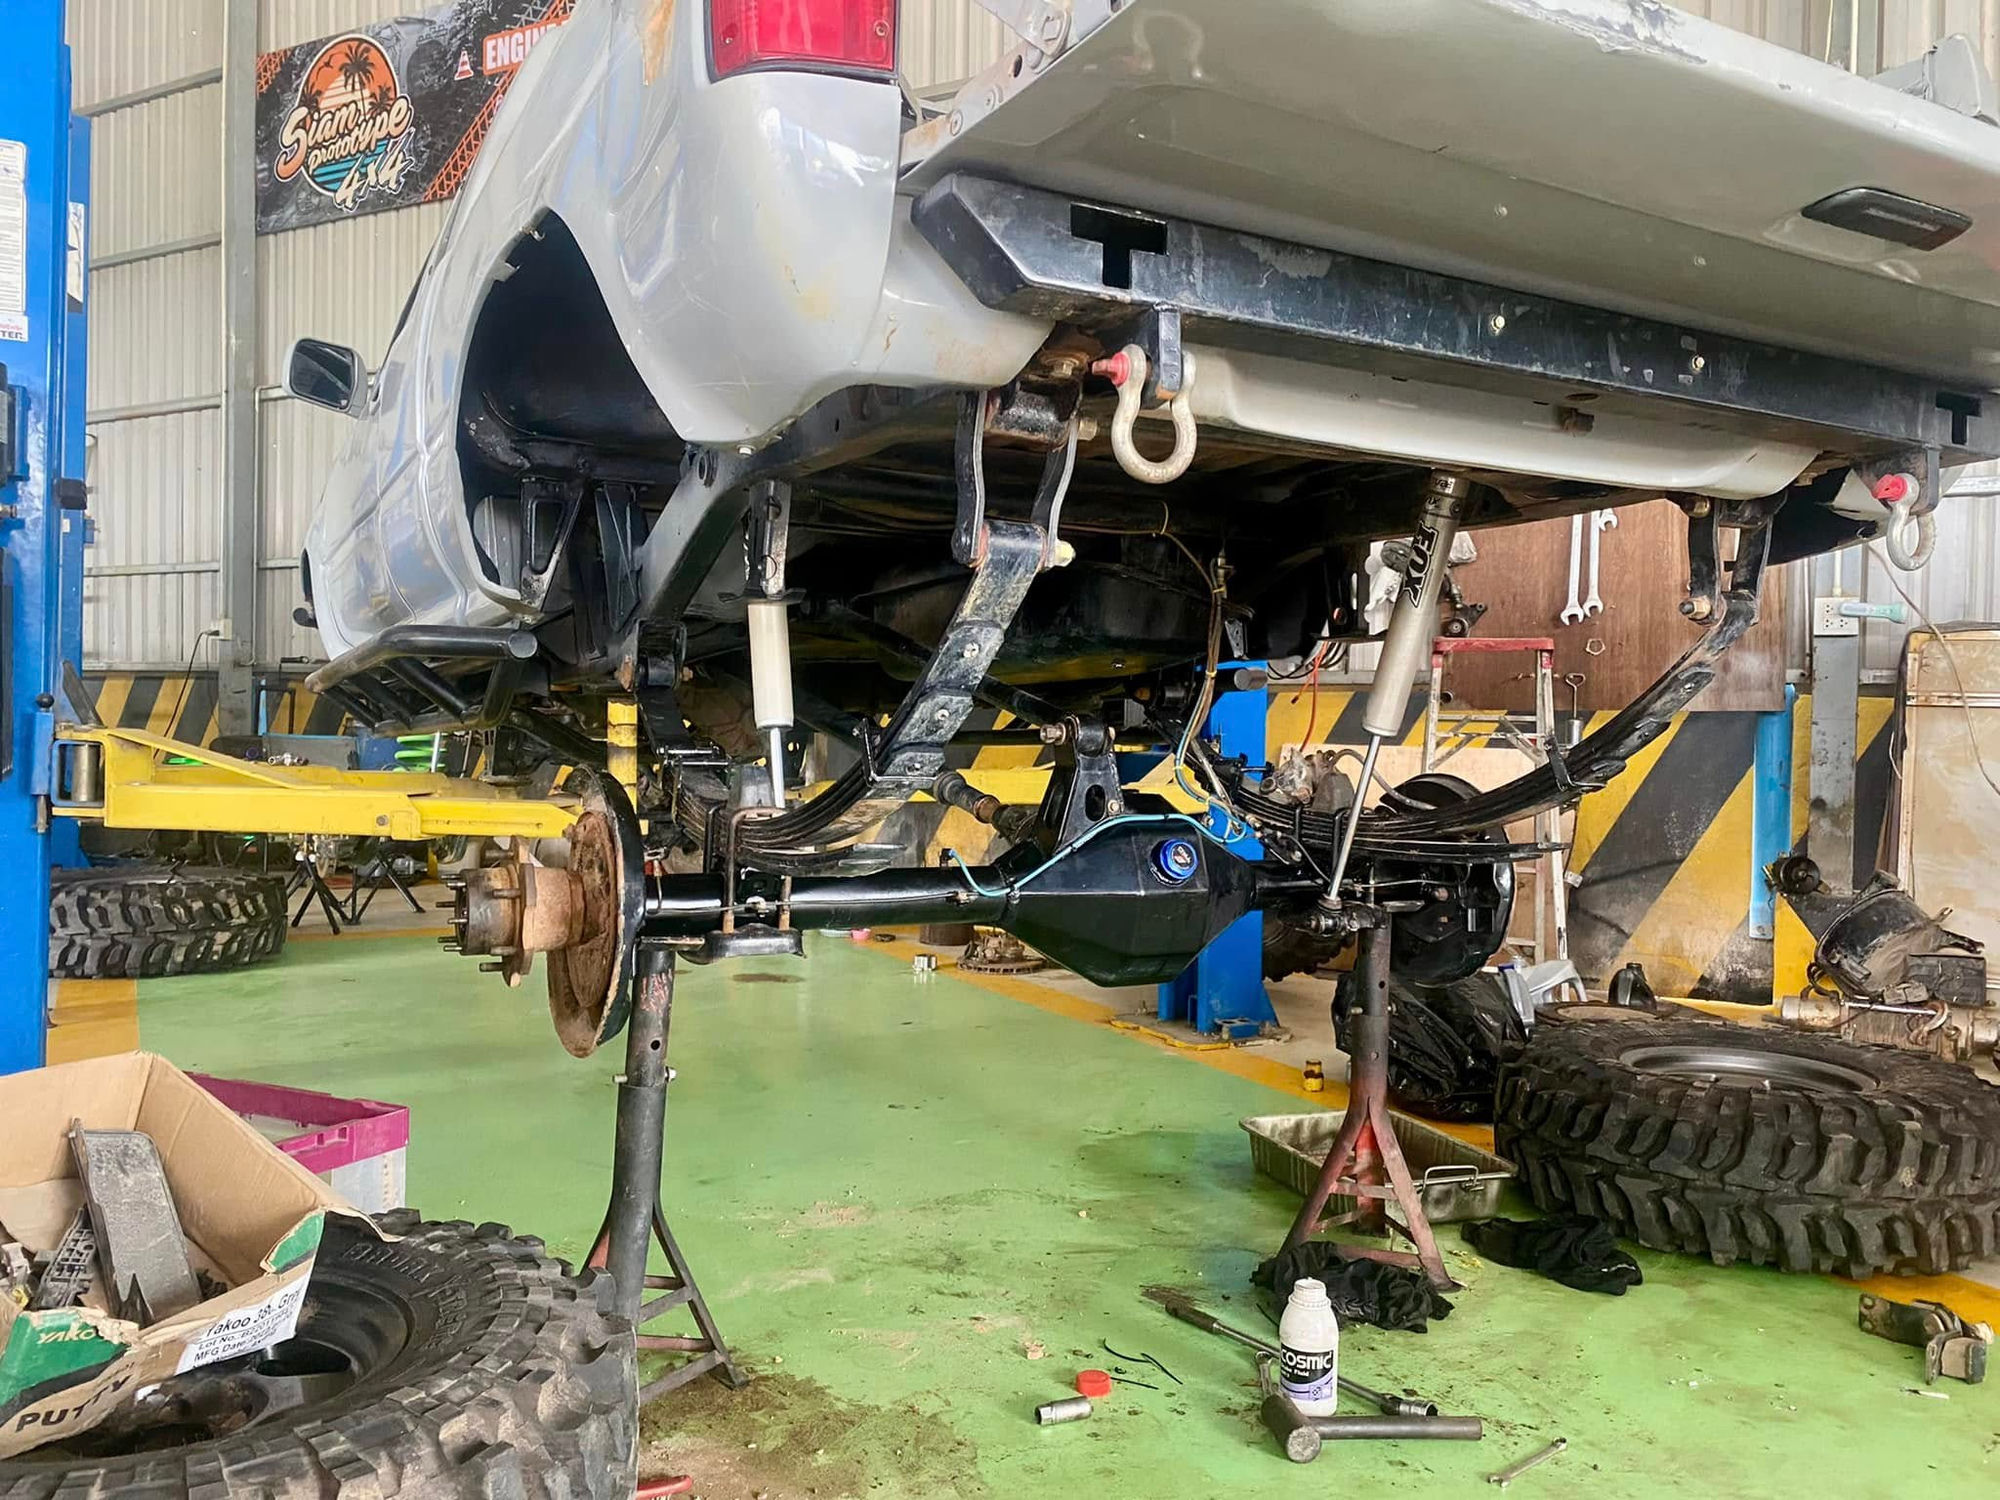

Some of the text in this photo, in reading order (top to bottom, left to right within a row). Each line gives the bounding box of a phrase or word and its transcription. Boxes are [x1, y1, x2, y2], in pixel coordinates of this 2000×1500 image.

[277, 101, 358, 179] Siam
[1403, 520, 1438, 608] FOX
[1281, 1348, 1332, 1370] COSMIC
